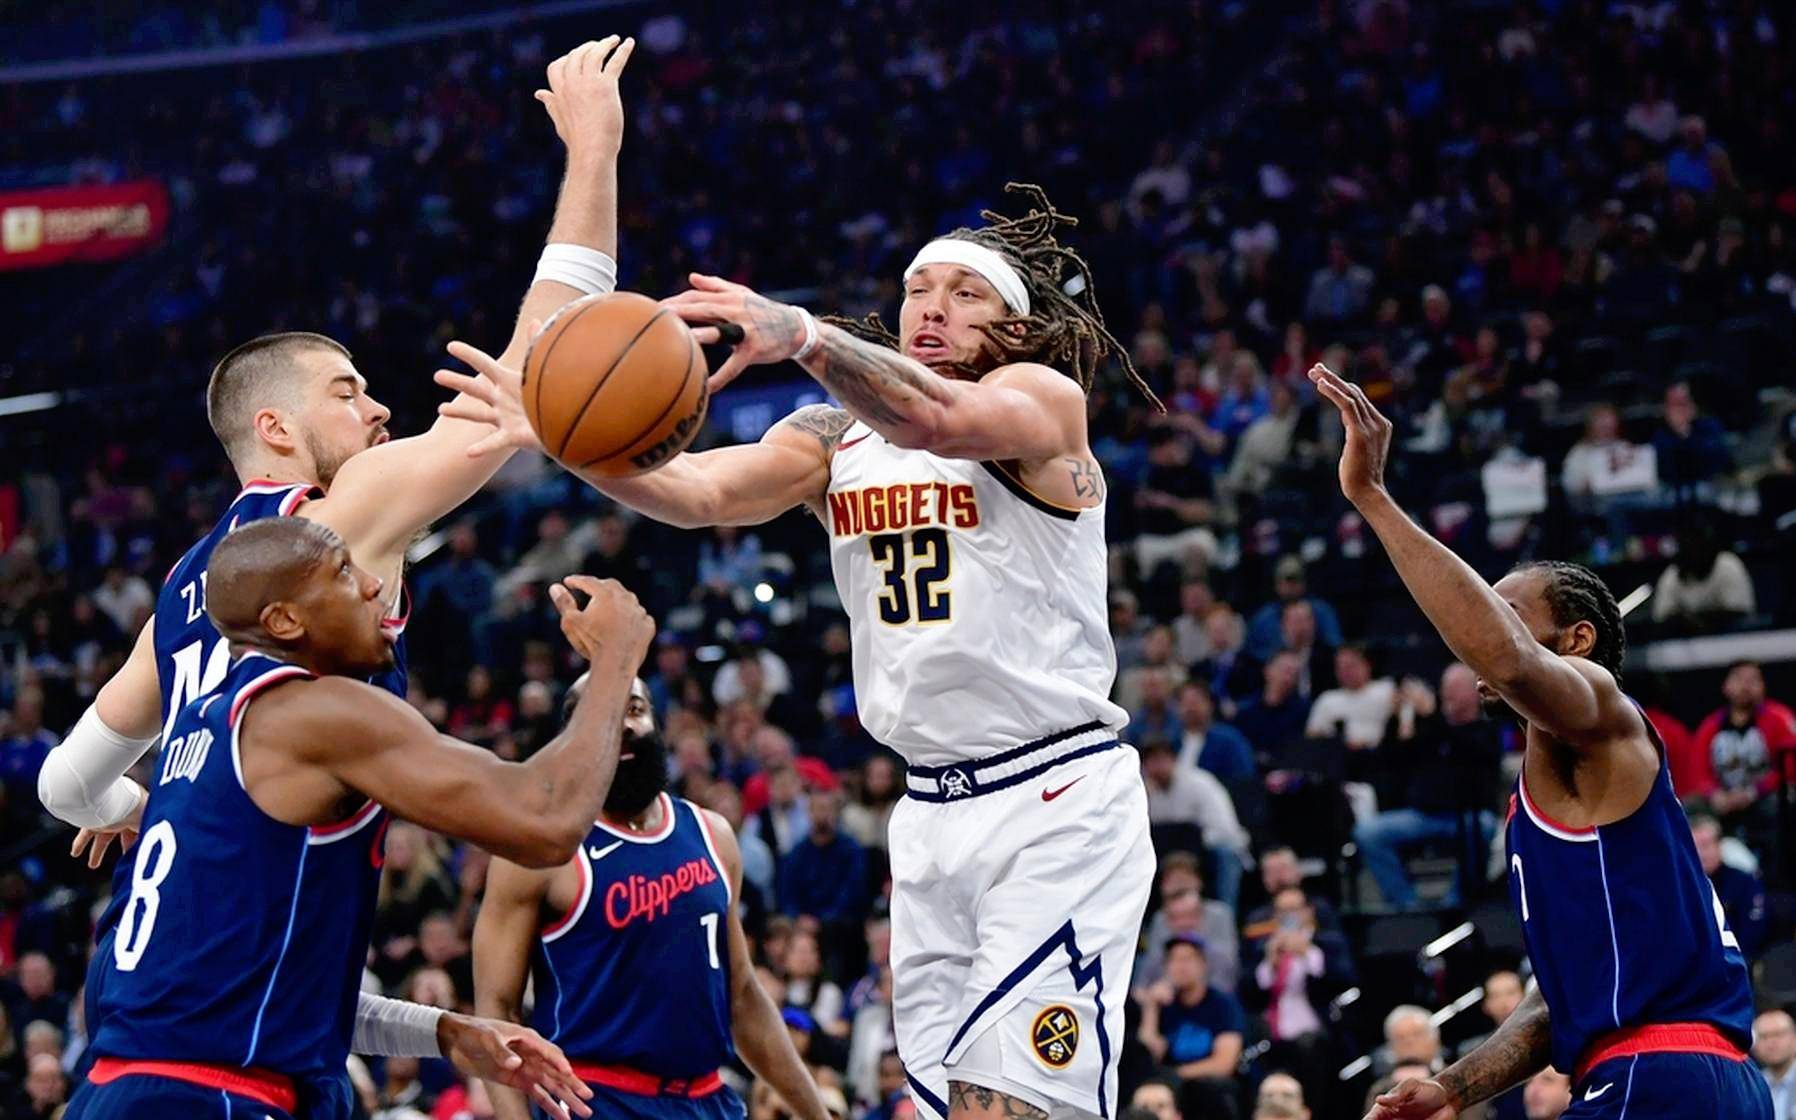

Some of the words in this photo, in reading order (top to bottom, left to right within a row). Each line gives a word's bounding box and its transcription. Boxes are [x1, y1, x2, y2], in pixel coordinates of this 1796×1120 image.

[828, 480, 980, 537] NUGGETS
[869, 527, 952, 626] 32
[114, 819, 177, 971] 8
[605, 857, 717, 929] Clippers
[700, 912, 720, 970] 1
